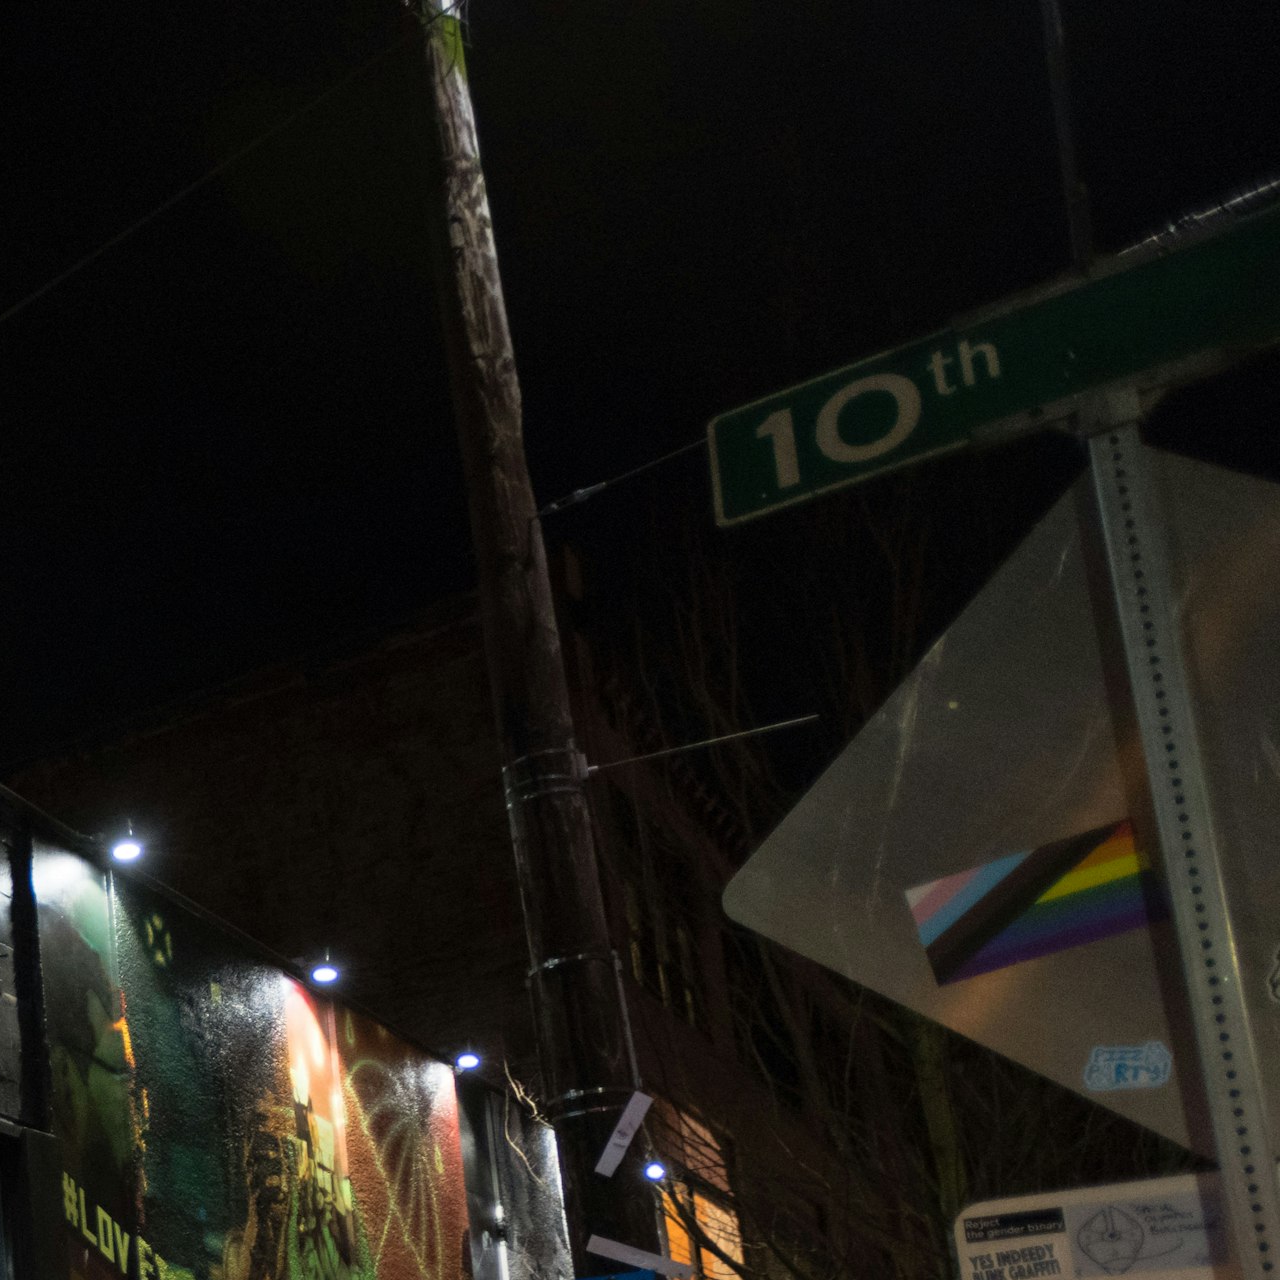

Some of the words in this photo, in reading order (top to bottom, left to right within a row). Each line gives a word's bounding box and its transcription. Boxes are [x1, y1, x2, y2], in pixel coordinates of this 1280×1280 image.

[755, 337, 1003, 490] 10th
[965, 1218, 1001, 1230] Reject
[967, 1230, 984, 1239] the
[986, 1225, 1025, 1240] gender
[1027, 1220, 1063, 1233] binary
[969, 1253, 994, 1270] YES
[996, 1243, 1054, 1267] INDEEDY
[1009, 1259, 1061, 1280] GRAFFITI
